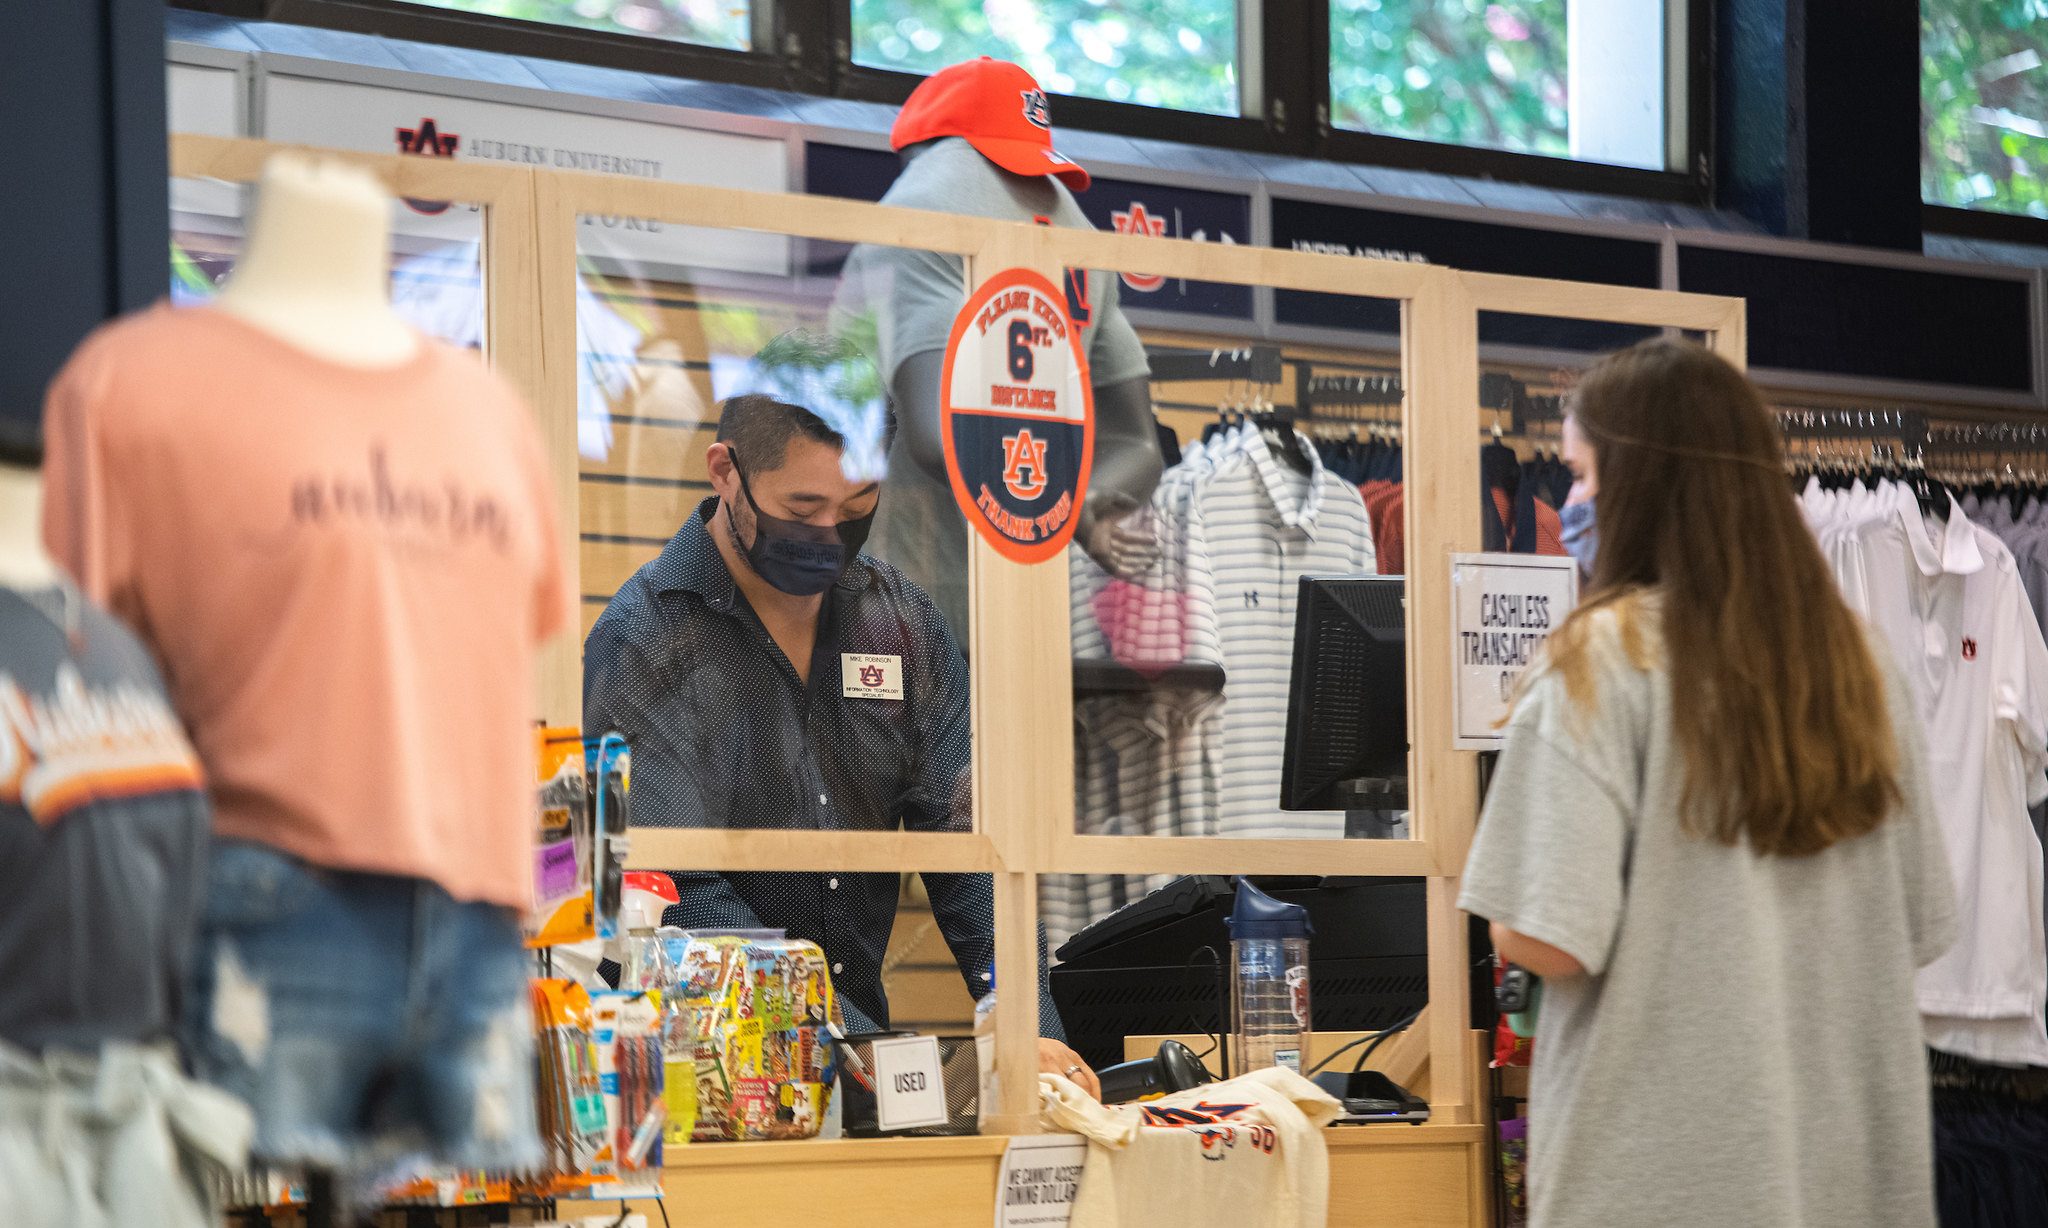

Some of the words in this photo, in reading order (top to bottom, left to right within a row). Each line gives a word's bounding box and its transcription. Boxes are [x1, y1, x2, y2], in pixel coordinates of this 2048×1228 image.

[469, 139, 547, 165] AUBURN
[554, 149, 663, 178] UNIVERSITY
[976, 291, 1030, 337] PLEASE
[1033, 295, 1066, 340] KEEP
[1007, 318, 1034, 382] 6
[1033, 327, 1052, 347] FT.
[991, 385, 1056, 411] DISTANCE
[976, 483, 1036, 541] THANK
[1481, 593, 1549, 629] CASHLESS
[1461, 631, 1548, 666] TRANSACT
[894, 1071, 927, 1094] USED
[1009, 1168, 1022, 1185] WE
[1022, 1166, 1054, 1184] CANNOT
[1006, 1184, 1038, 1206] DINING
